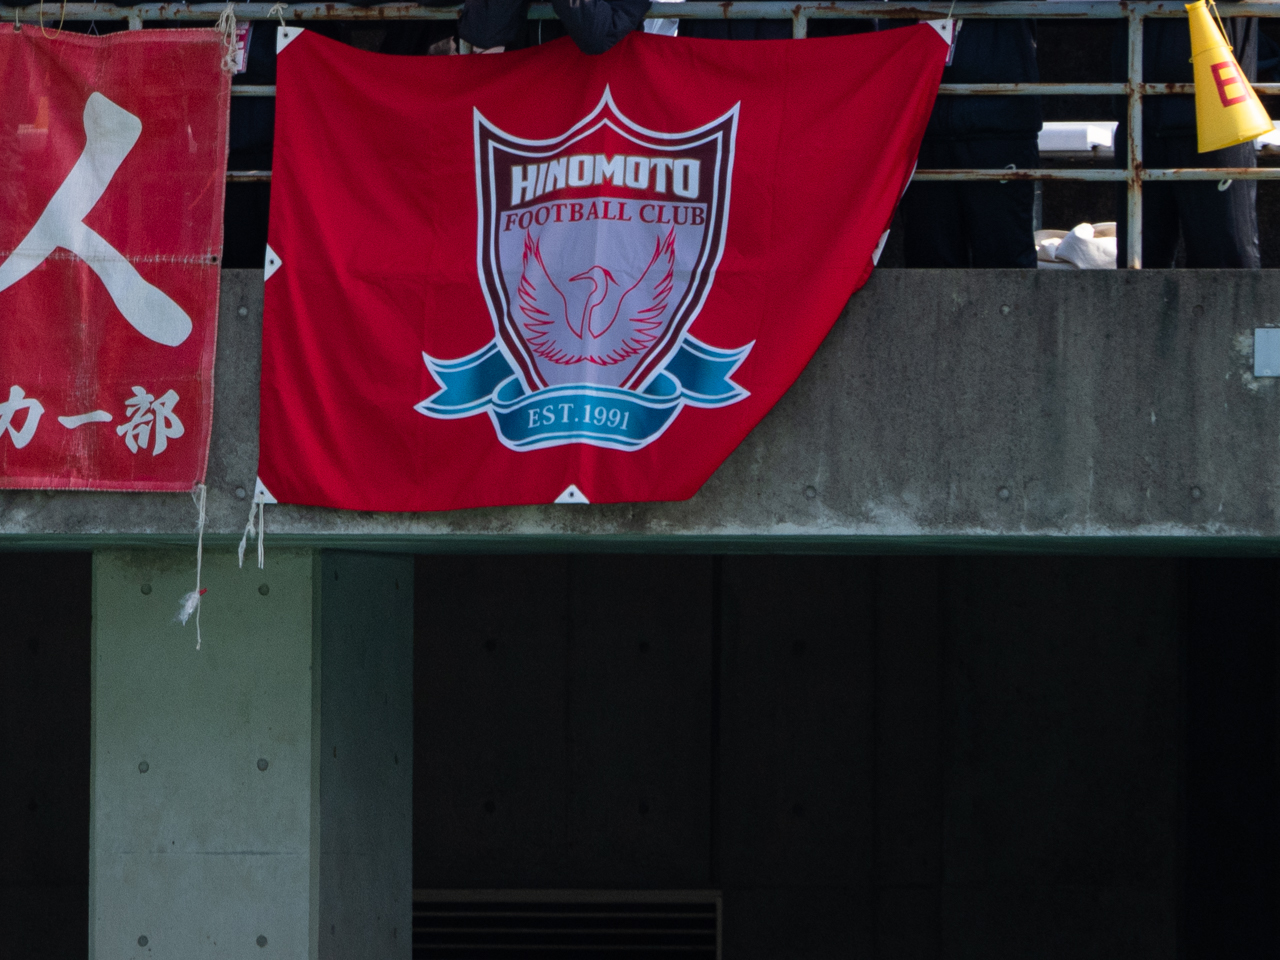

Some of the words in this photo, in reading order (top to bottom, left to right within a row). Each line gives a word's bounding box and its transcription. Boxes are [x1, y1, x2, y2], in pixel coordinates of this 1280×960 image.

[511, 154, 701, 205] HINOMOTO
[504, 200, 632, 231] FOOTBALL
[639, 203, 706, 227] CLUB
